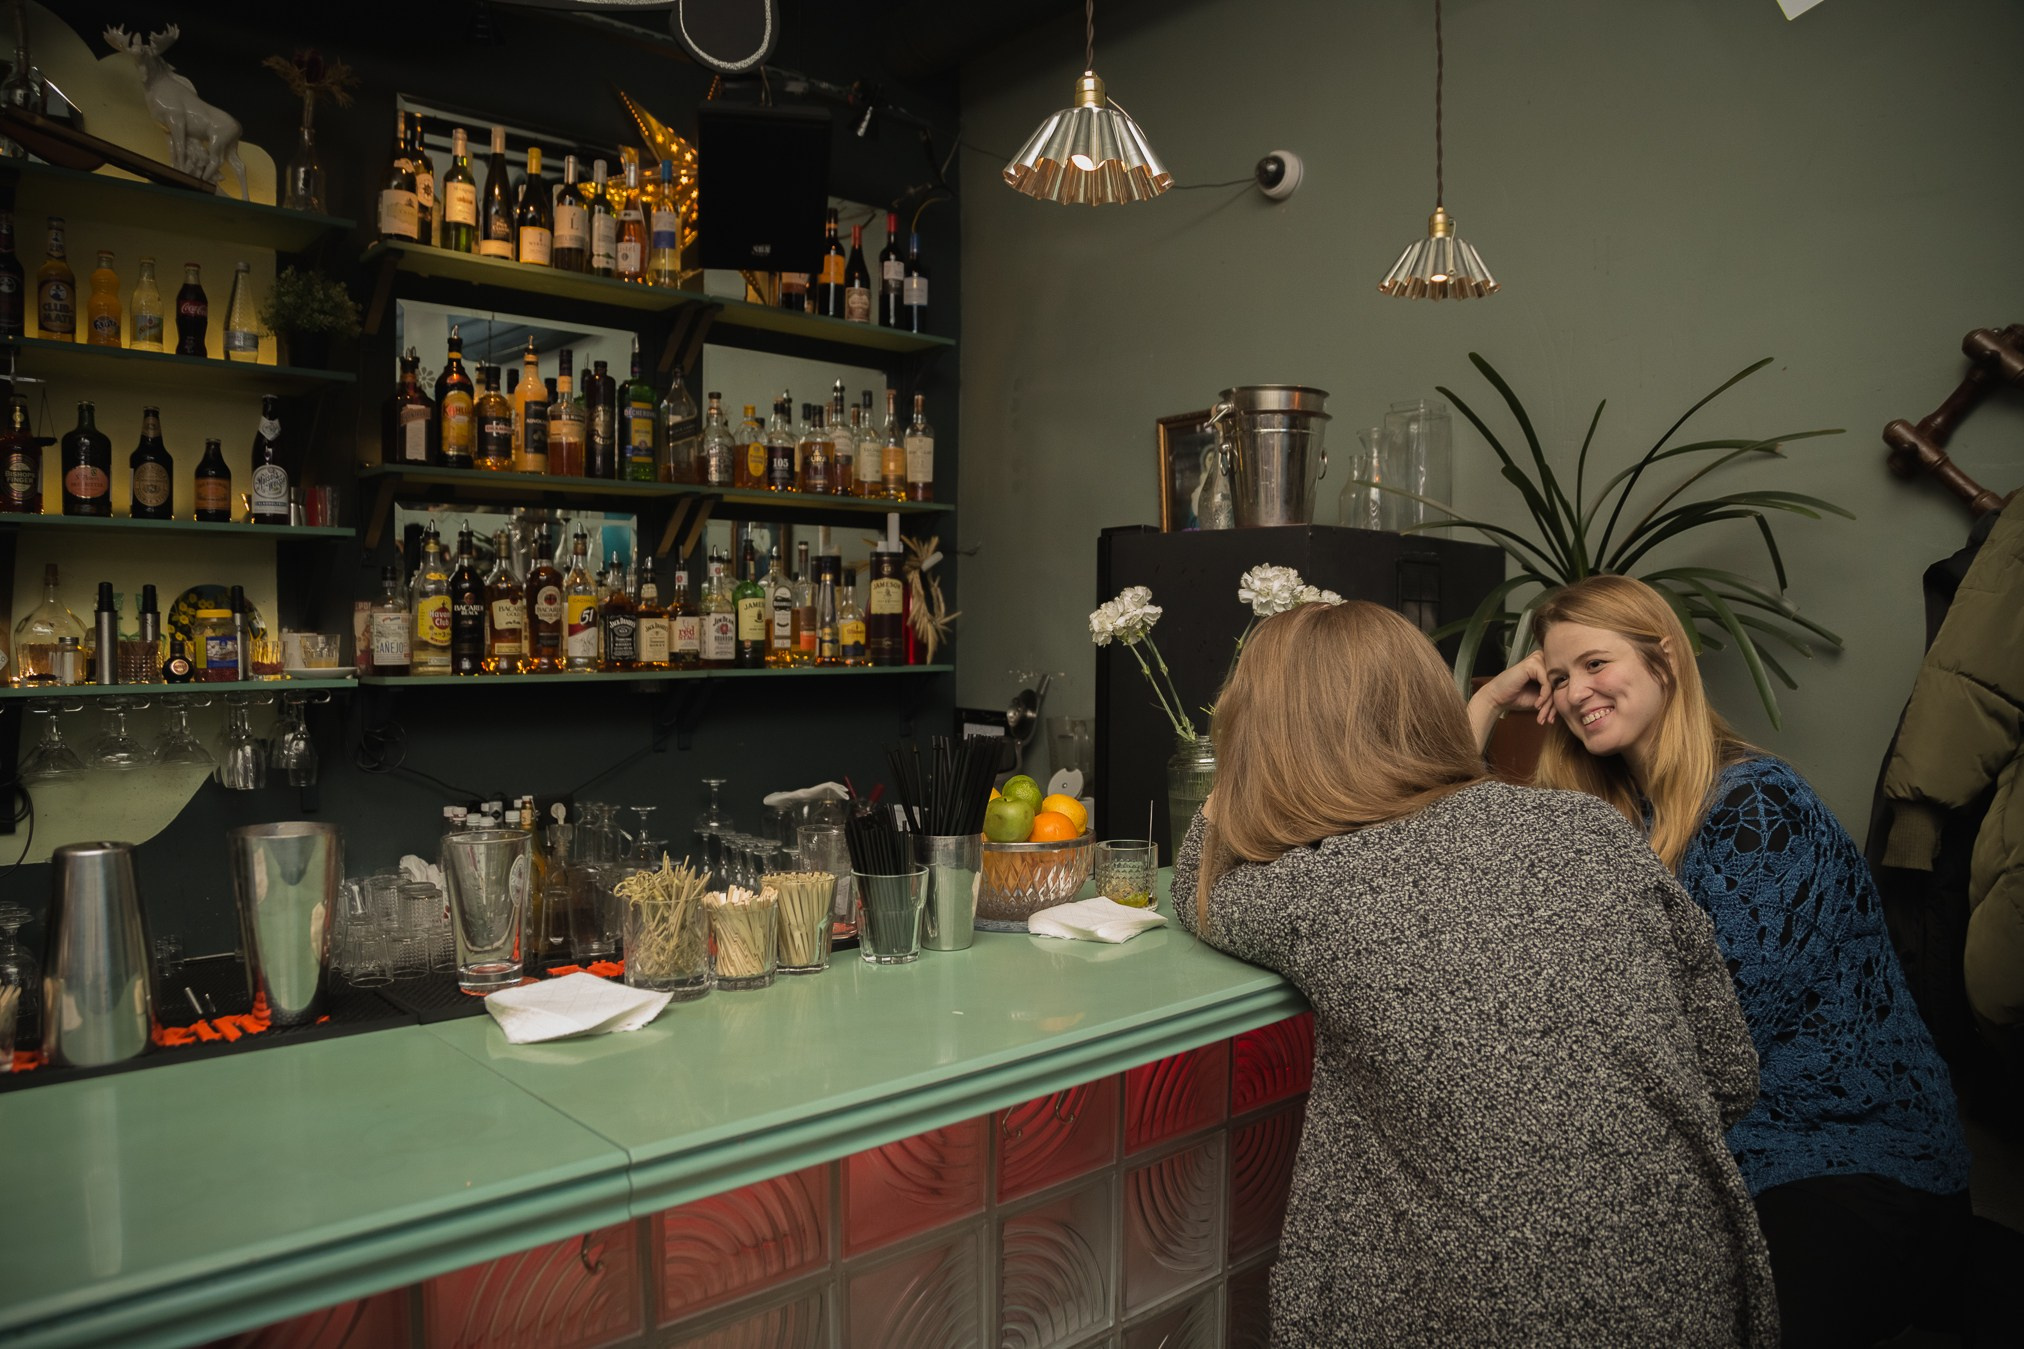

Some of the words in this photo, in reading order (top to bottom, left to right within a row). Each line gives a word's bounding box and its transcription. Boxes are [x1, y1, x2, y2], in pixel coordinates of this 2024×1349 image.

[772, 457, 789, 468] 105
[873, 581, 901, 590] JAMESON
[454, 604, 484, 612] BACARDI
[580, 608, 594, 625] 51
[434, 618, 450, 627] Club
[713, 617, 722, 627] JIM
